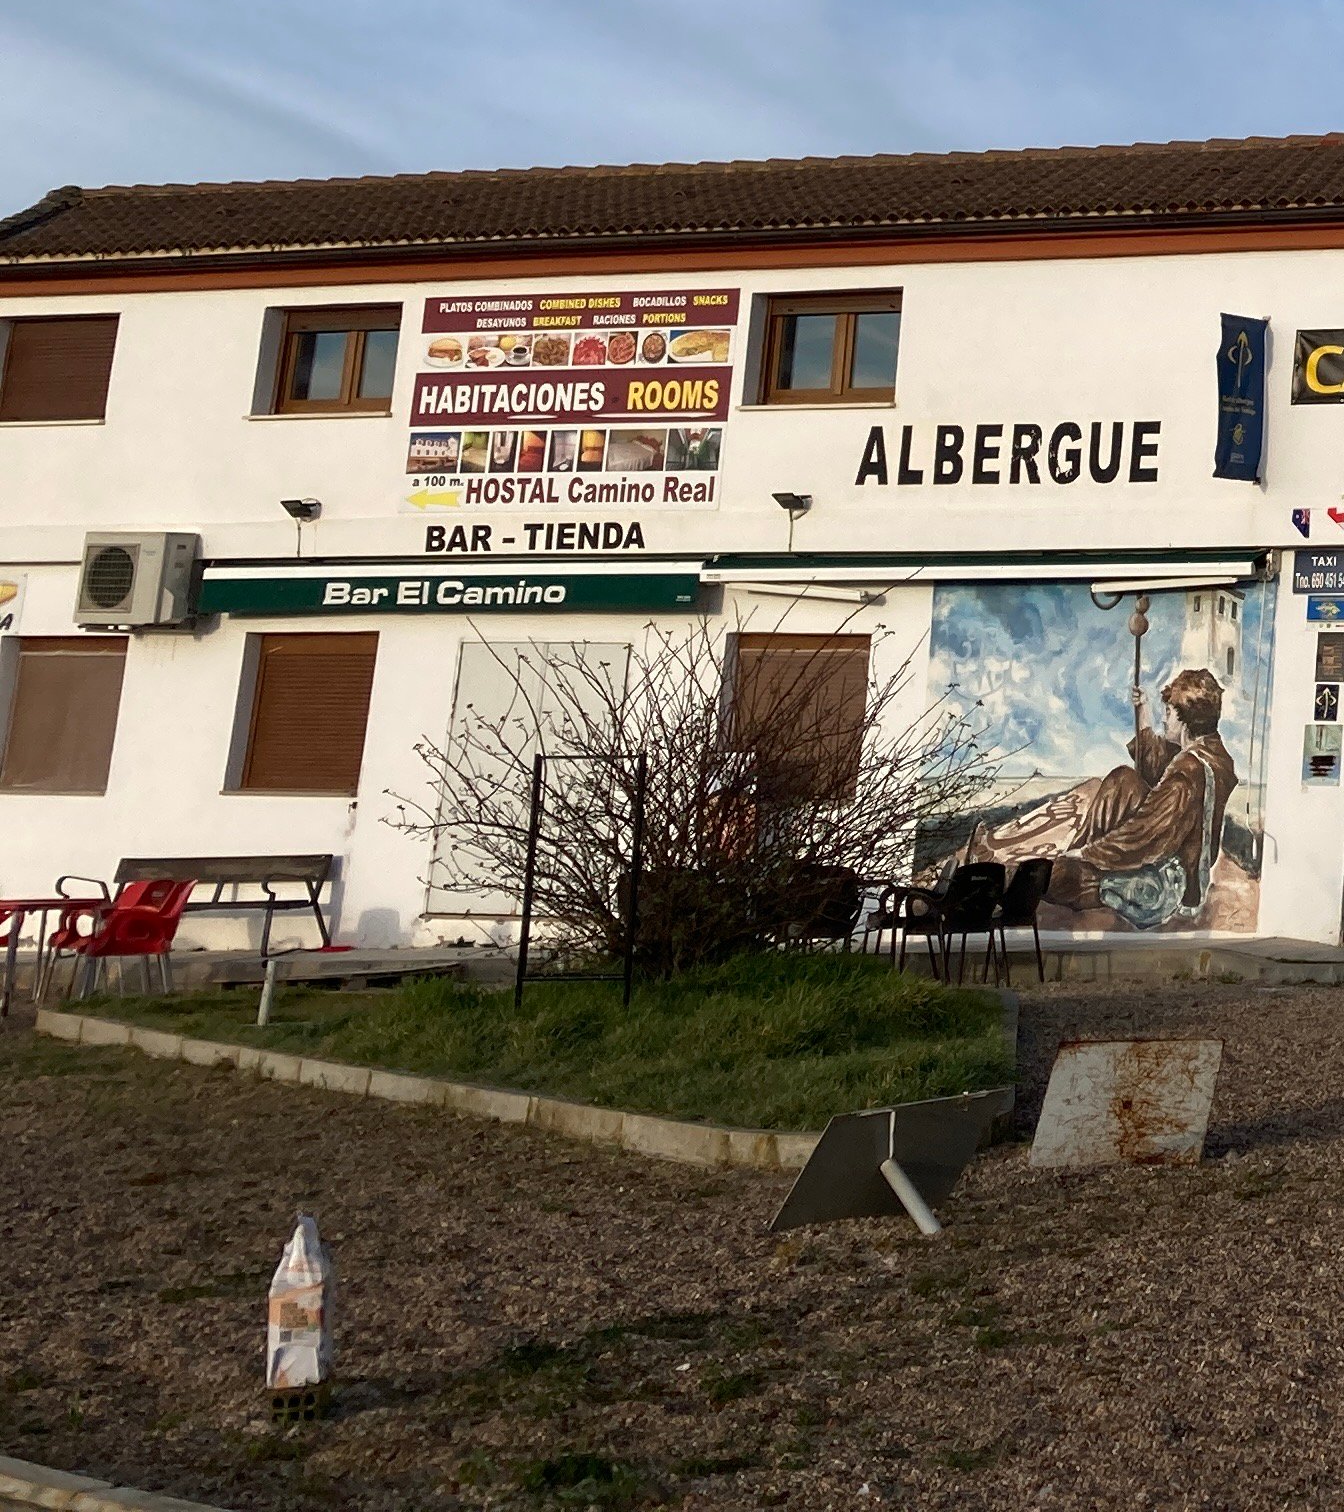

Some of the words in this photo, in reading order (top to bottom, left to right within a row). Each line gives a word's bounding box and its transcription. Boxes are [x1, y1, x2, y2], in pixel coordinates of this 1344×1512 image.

[439, 300, 473, 314] PLATOS
[474, 298, 534, 313] COMBINADOS
[539, 297, 586, 311] COMBINED
[588, 296, 622, 309] DISHES
[632, 295, 687, 308] BOCADILLOS
[693, 294, 729, 306] SNACKS
[476, 316, 528, 329] DESAYUNOS
[533, 315, 583, 328] BREAKFAST
[592, 313, 637, 326] RACIONES
[642, 312, 687, 325] PORTIONS
[418, 381, 606, 416] HABITACIONES
[626, 379, 720, 411] ROOMS
[855, 421, 1162, 486] ALBERGUE
[411, 480, 422, 488] a
[423, 475, 446, 488] 100
[465, 477, 562, 505] HOSTAL
[567, 476, 655, 504] Camino
[662, 476, 716, 504] Real
[425, 524, 493, 553] BAR
[523, 521, 646, 551] TIENDA
[1311, 556, 1337, 567] TAXI
[322, 583, 388, 606] Bar
[395, 581, 430, 605] El
[437, 580, 567, 605] Camino
